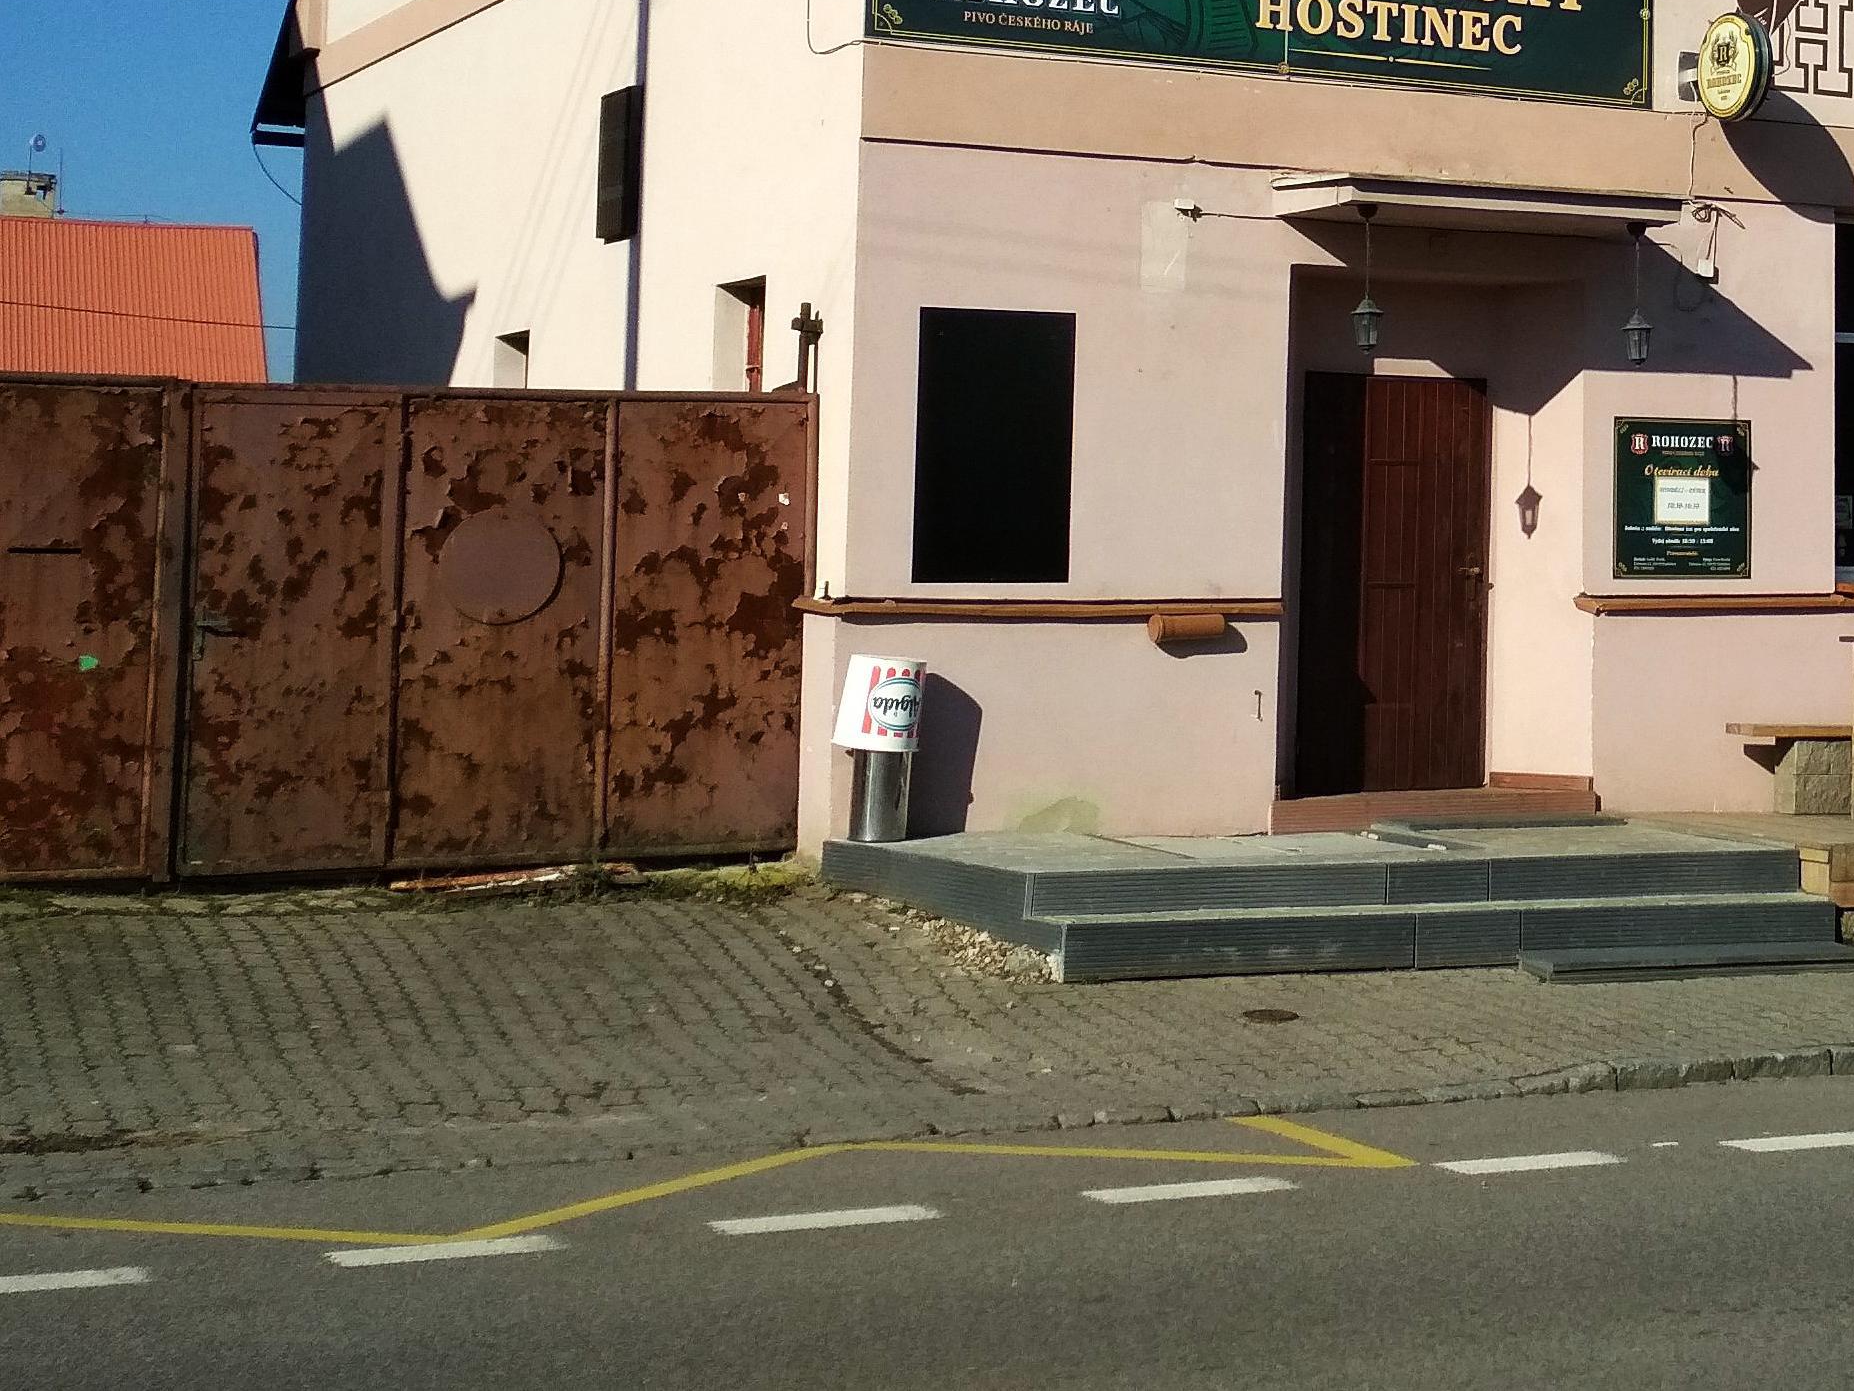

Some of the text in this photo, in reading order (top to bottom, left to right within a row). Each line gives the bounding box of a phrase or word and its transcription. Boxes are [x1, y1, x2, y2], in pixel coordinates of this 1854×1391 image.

[963, 11, 1095, 36] PIVO ČESKÉHO RÁJE
[1651, 435, 1714, 449] ROHOZEC
